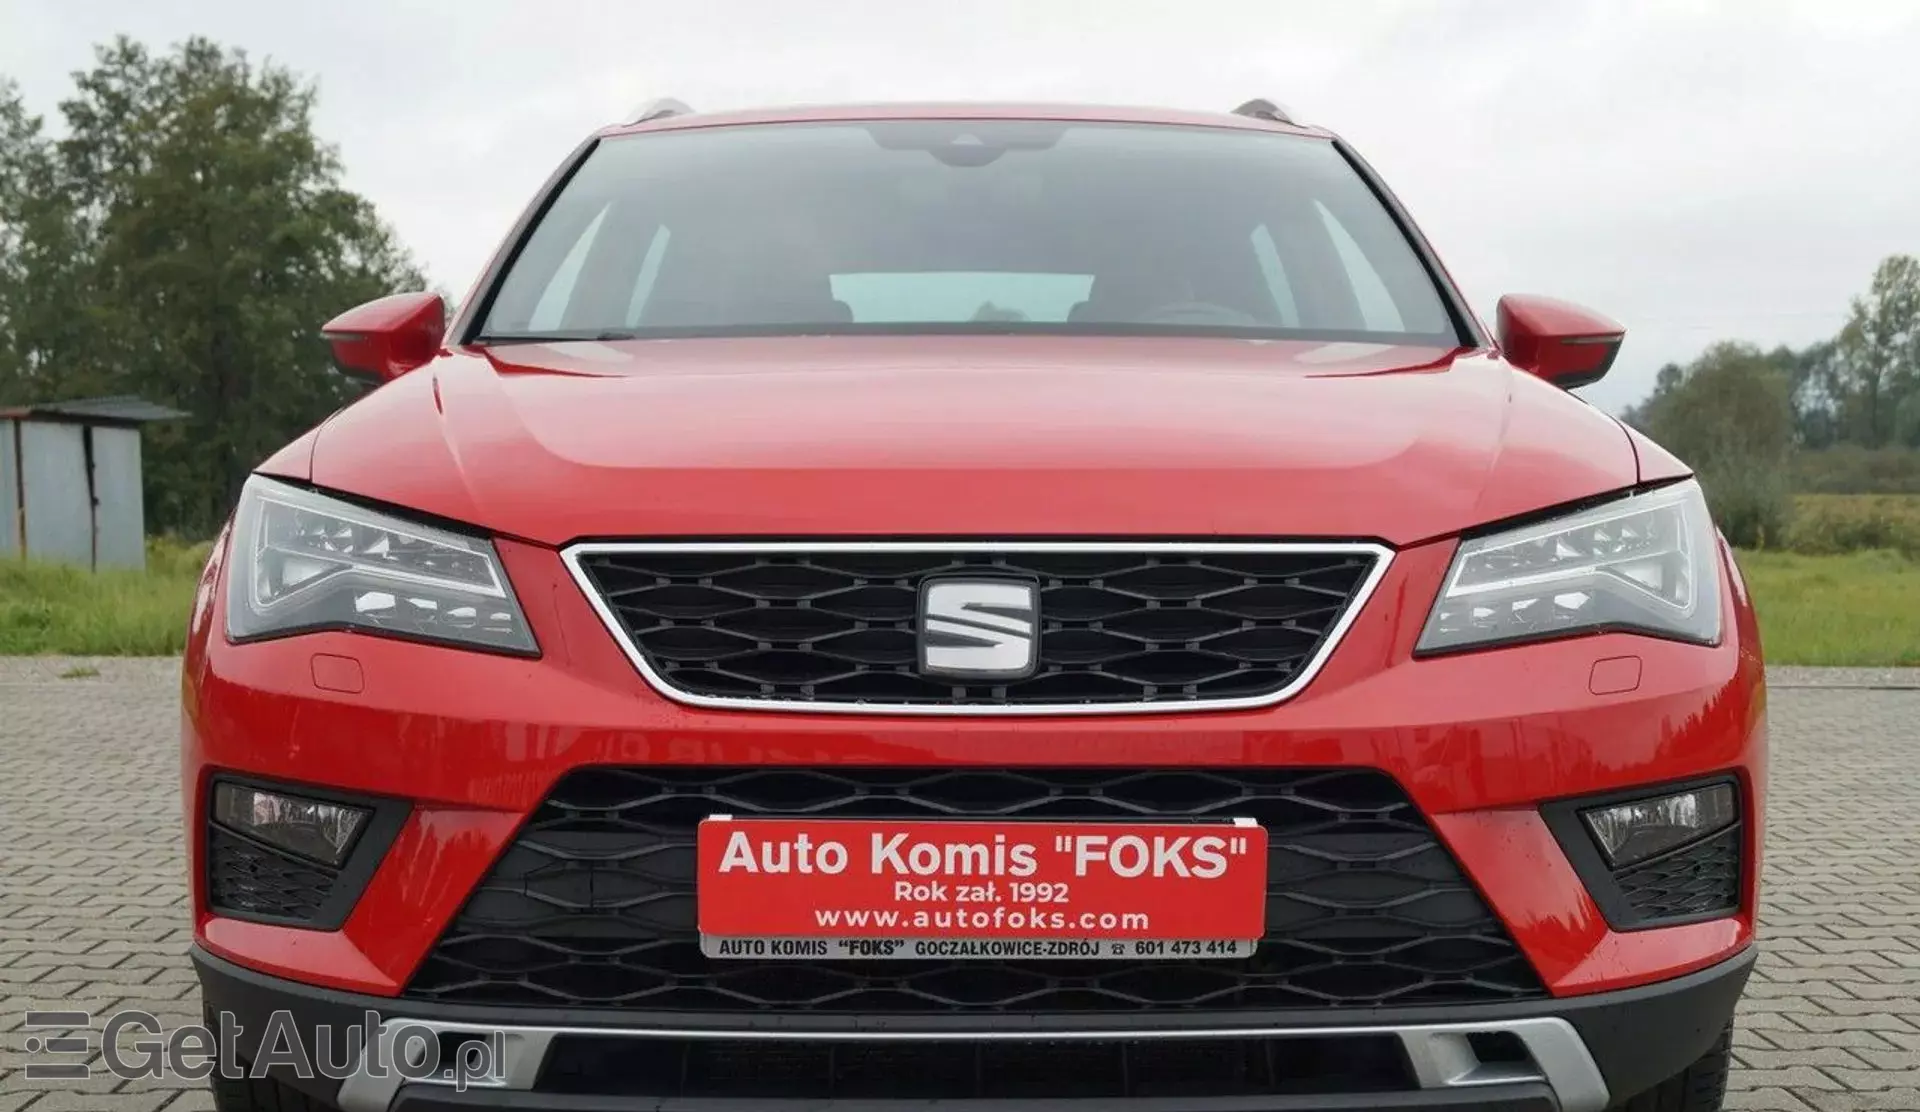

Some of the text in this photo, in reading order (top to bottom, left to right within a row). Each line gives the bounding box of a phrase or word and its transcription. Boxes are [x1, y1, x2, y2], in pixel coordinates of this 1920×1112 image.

[719, 831, 1247, 879] Auto Komis "FOKS"
[894, 880, 1070, 904] Rok zał. 1992
[815, 906, 1150, 930] www.autofoks.com
[719, 939, 767, 956] AUTO
[770, 939, 828, 956] KOMIS
[915, 938, 1100, 956] GOCZAŁKOWICE-ZDRÓJ
[1135, 939, 1167, 955] 601
[1171, 939, 1202, 955] 473
[1205, 939, 1238, 955] 414
